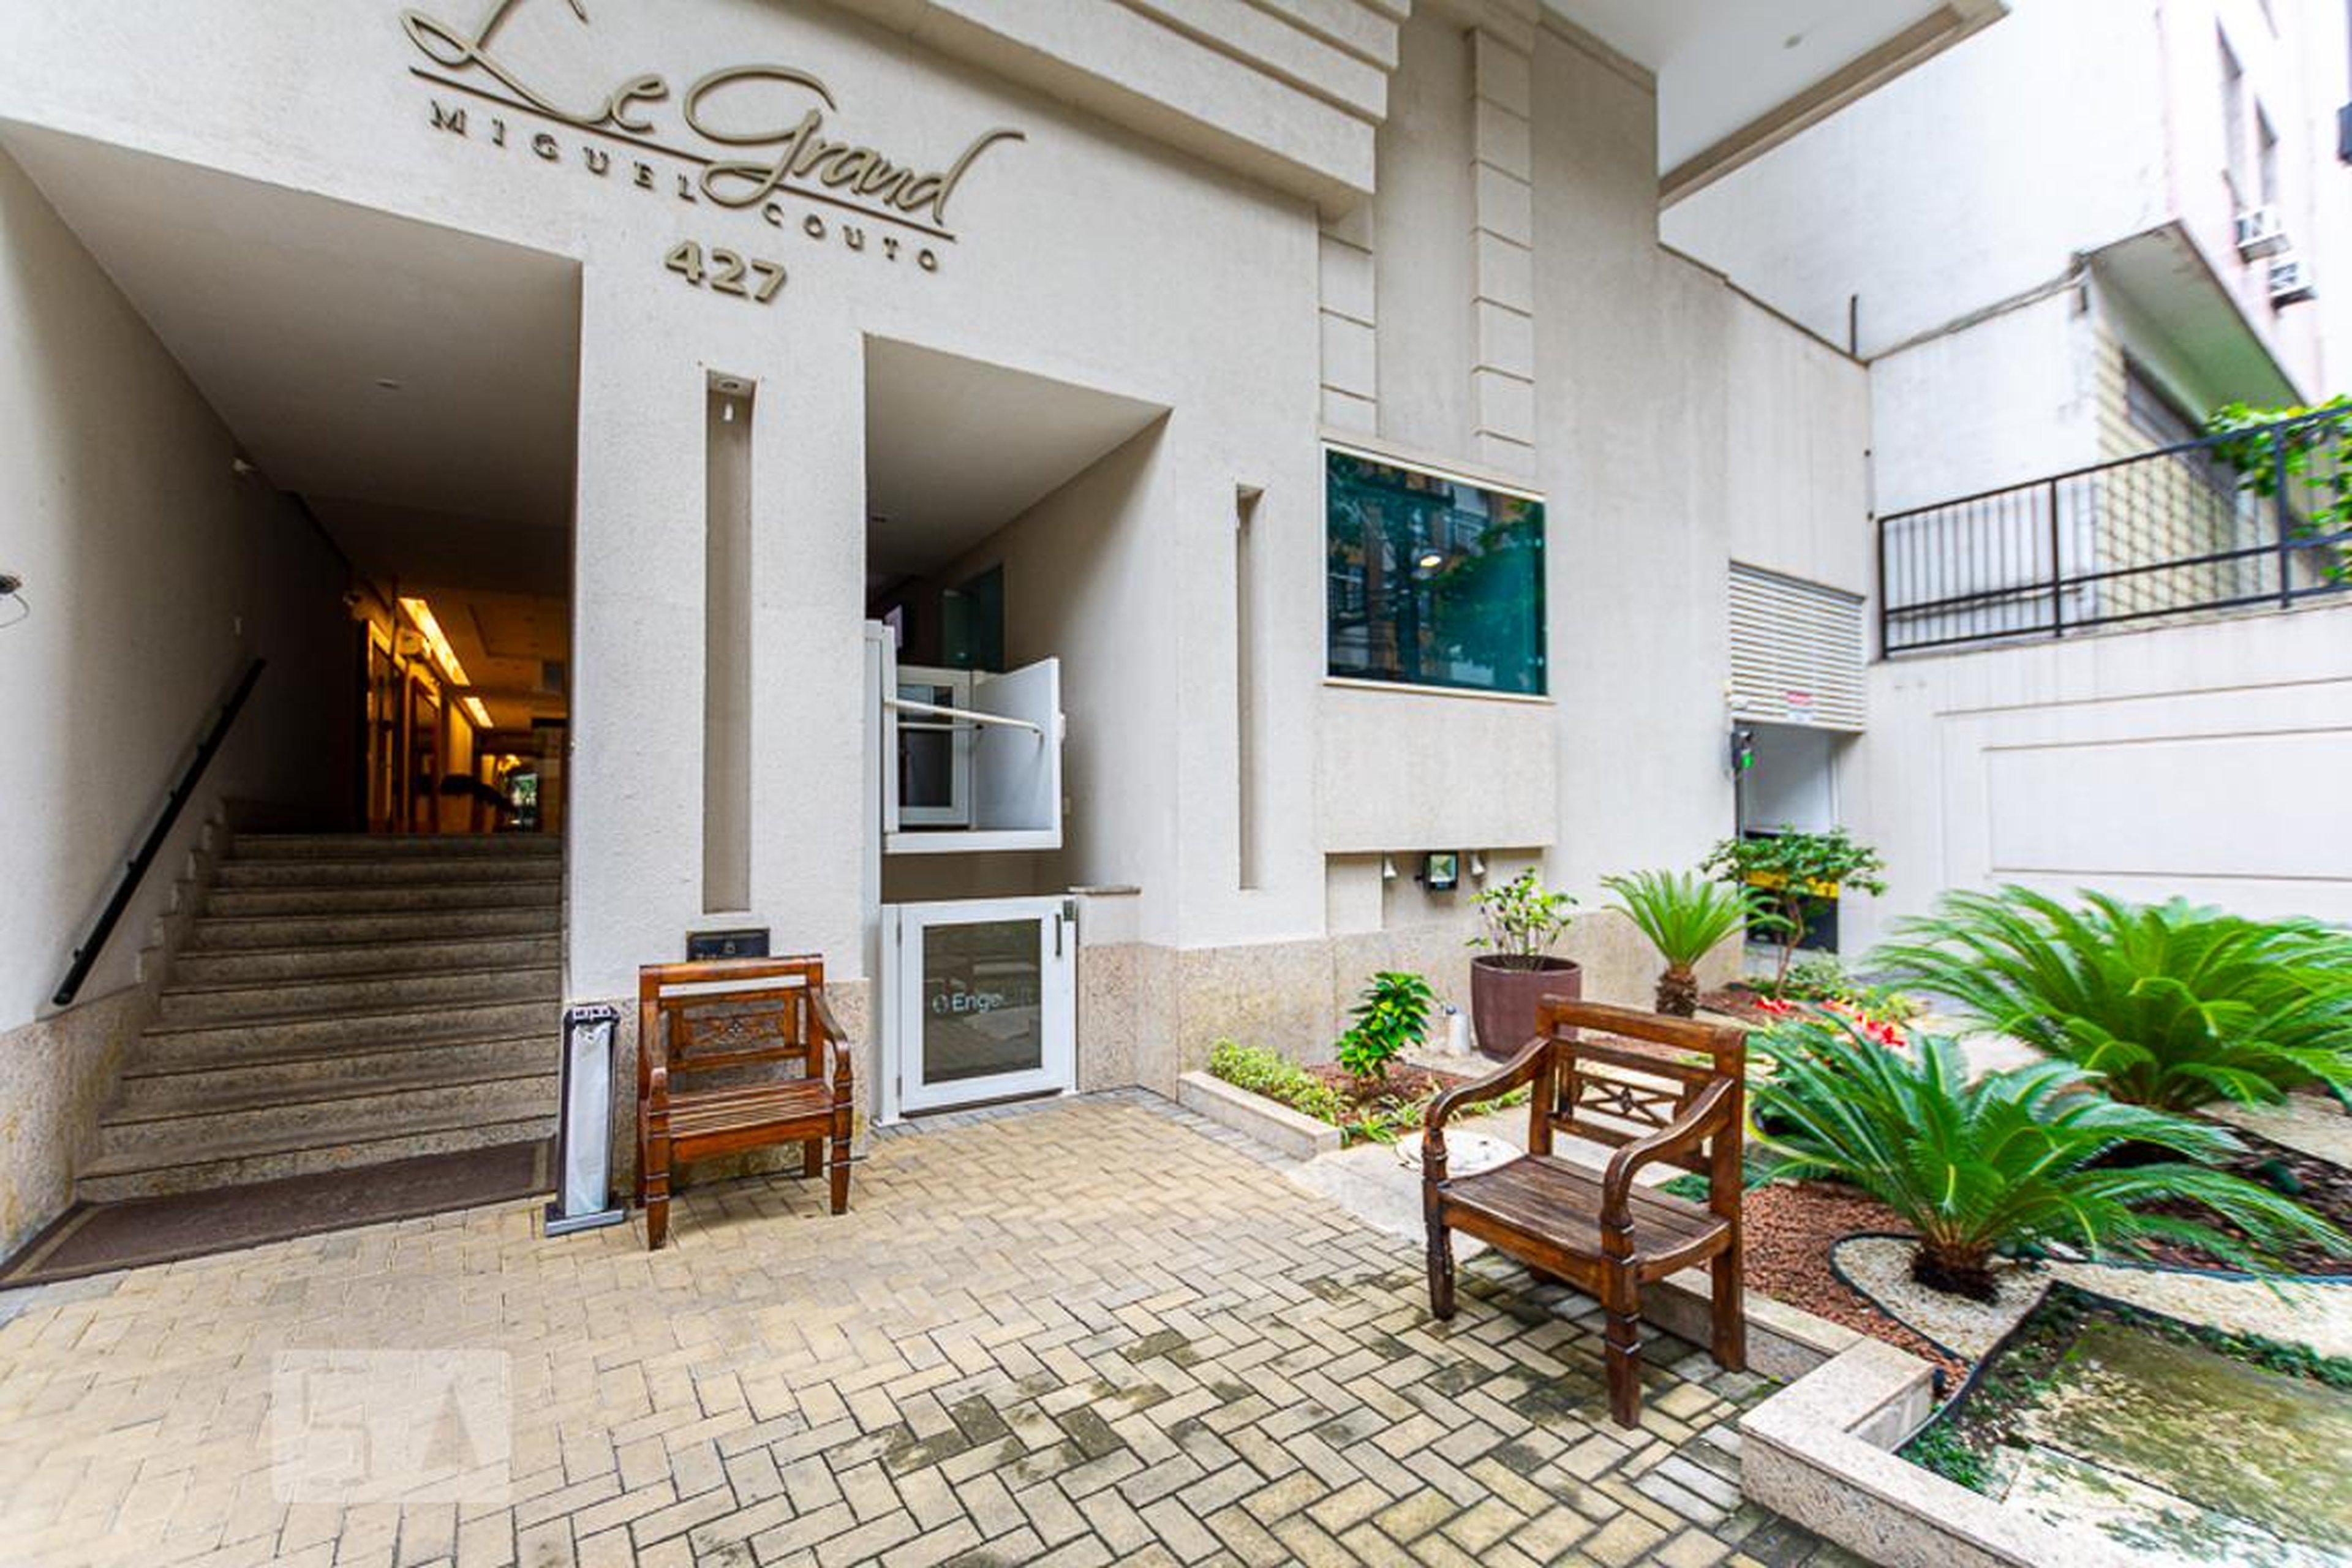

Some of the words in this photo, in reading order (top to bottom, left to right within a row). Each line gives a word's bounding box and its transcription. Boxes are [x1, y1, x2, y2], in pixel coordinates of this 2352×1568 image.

[401, 0, 670, 132] Le
[685, 65, 1026, 224] Grand
[429, 100, 698, 202] MIGUEL
[764, 202, 939, 271] COUTO
[666, 240, 788, 303] 427
